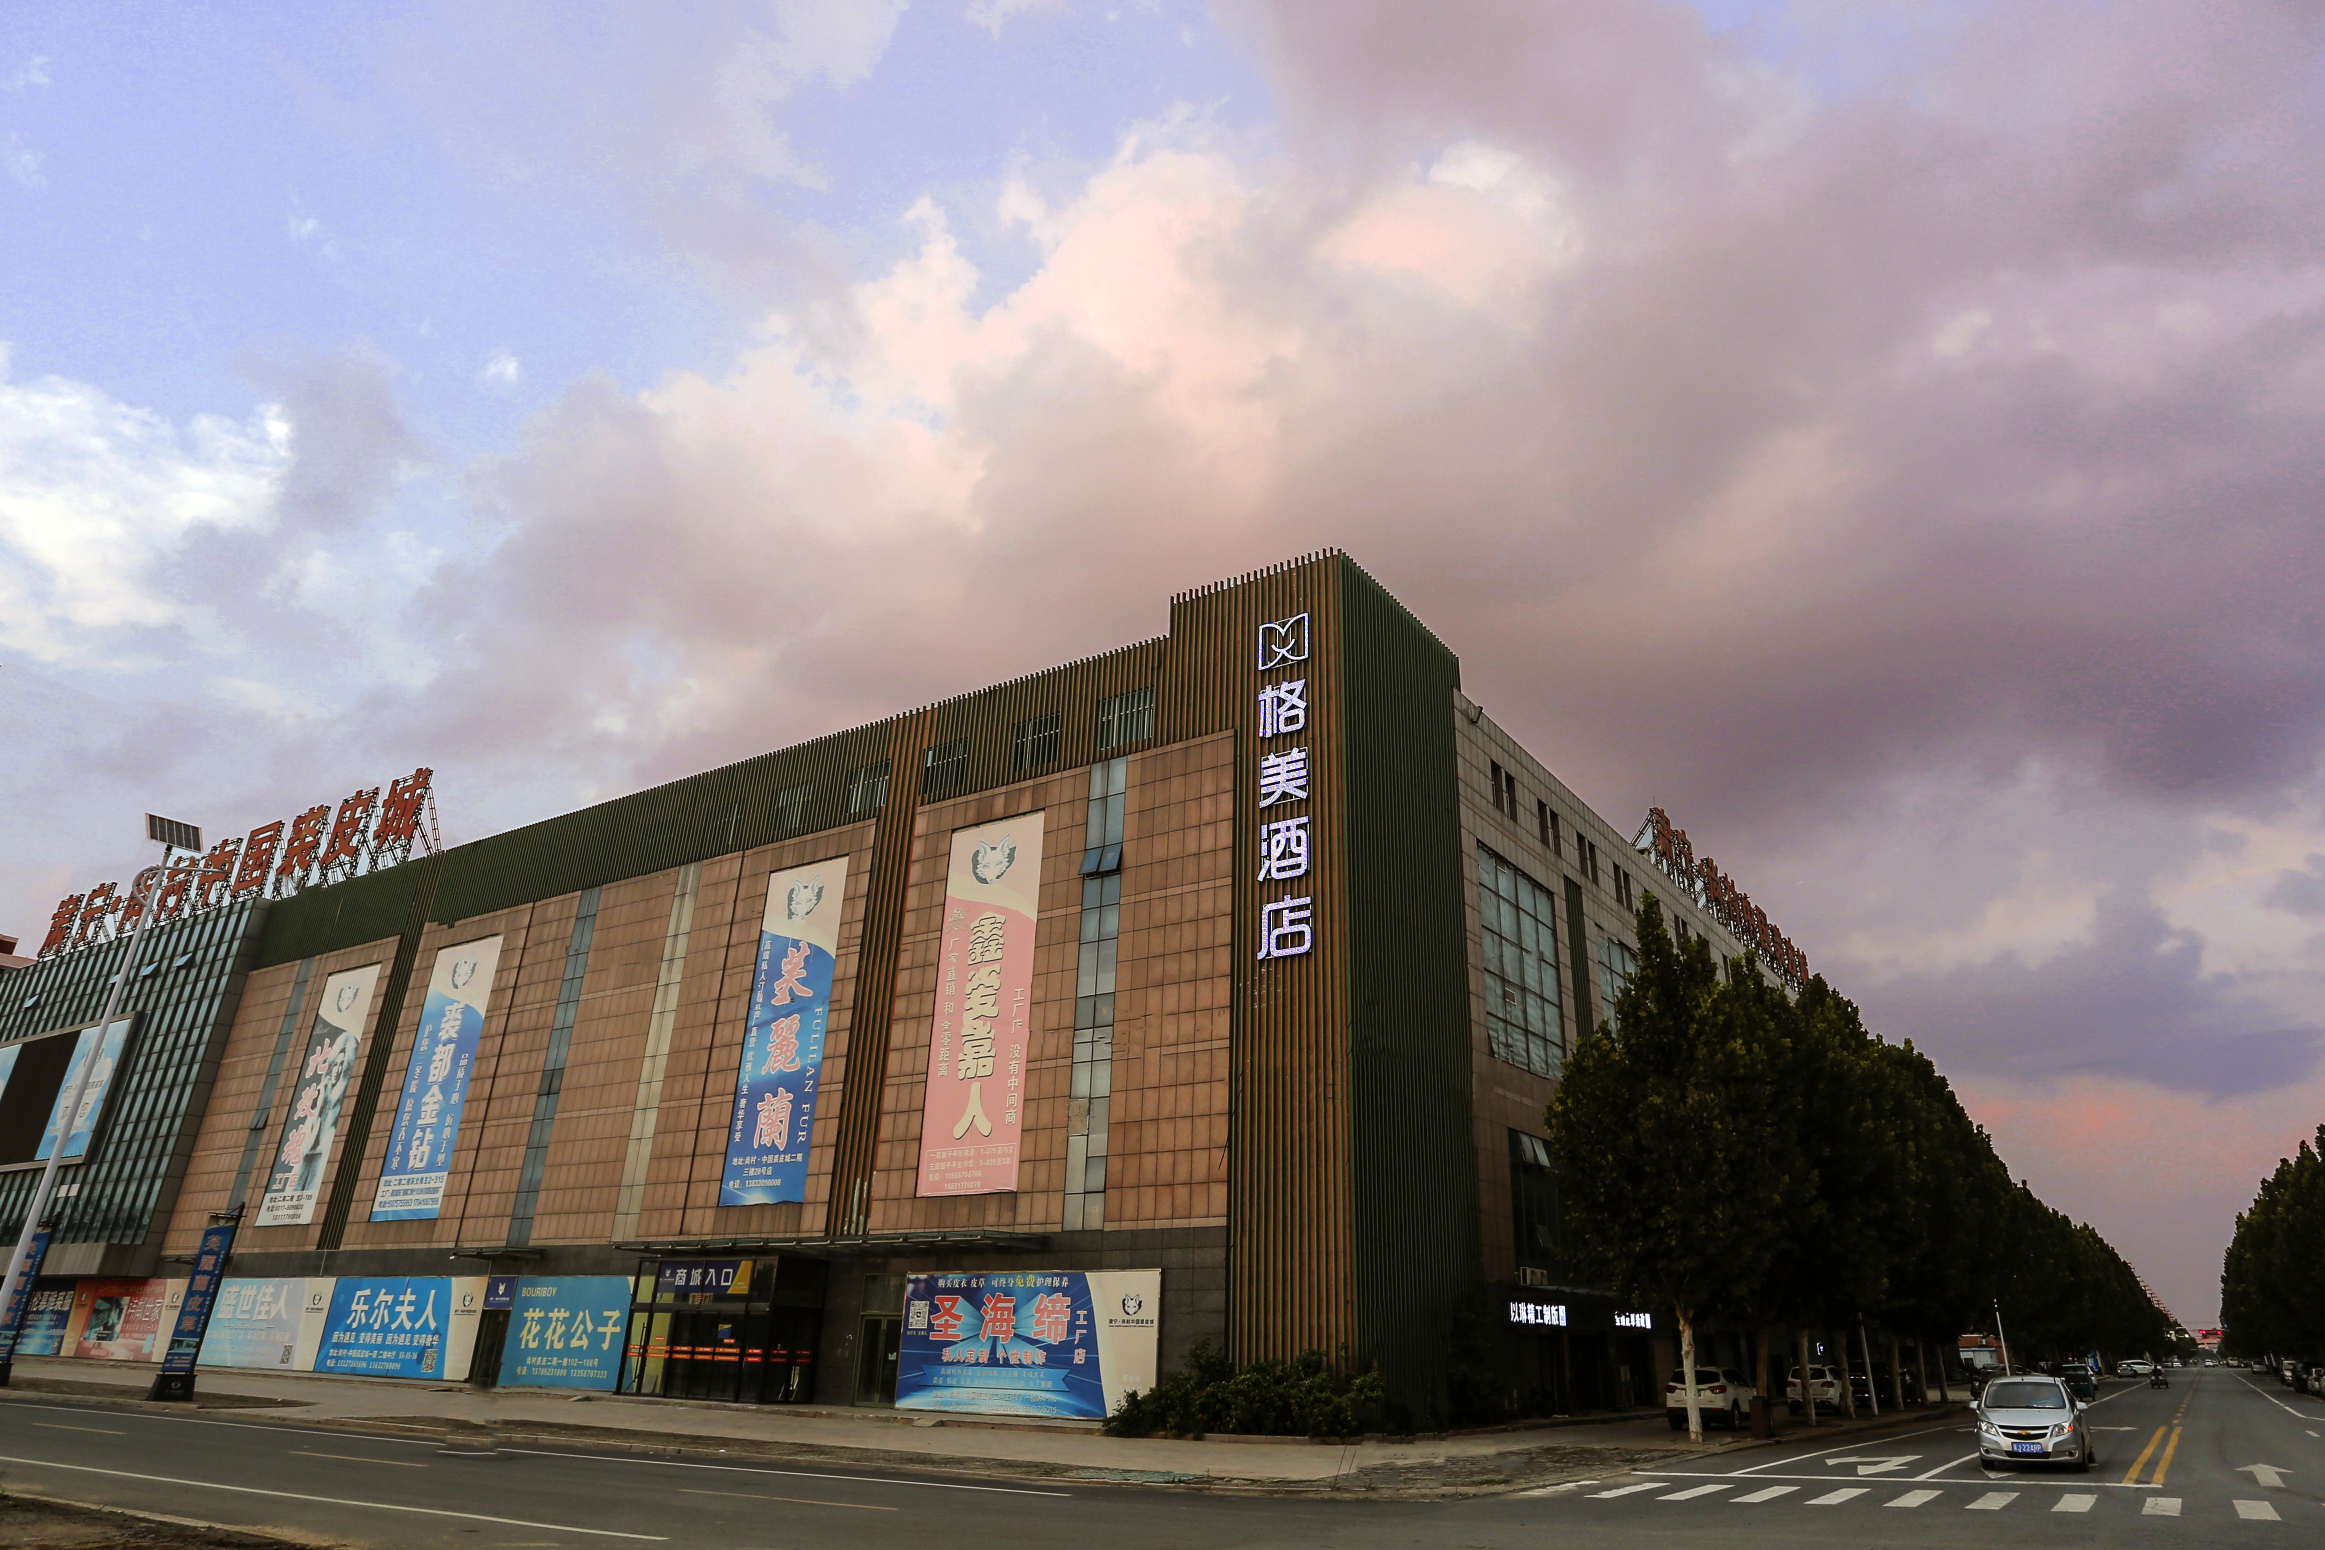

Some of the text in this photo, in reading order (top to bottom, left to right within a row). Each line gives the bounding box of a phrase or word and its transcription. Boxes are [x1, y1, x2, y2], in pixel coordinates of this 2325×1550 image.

[1257, 678, 1312, 961] 格美酒店
[797, 1007, 823, 1144] FULILAN FUR
[1005, 1044, 1021, 1125] 没有中间商
[521, 1287, 557, 1297] BOURIBOY
[674, 1268, 734, 1286] 商城入口
[937, 1277, 968, 1289] 购买皮衣
[970, 1278, 986, 1289] 皮草
[216, 1285, 289, 1321] 盛世佳人
[347, 1288, 438, 1330] 乐尔夫人
[929, 1292, 1071, 1344] 圣海缔
[519, 1308, 622, 1350] 花花公子
[1073, 1310, 1087, 1365] 工厂店
[941, 1348, 1047, 1365] 私人定制 个性制作
